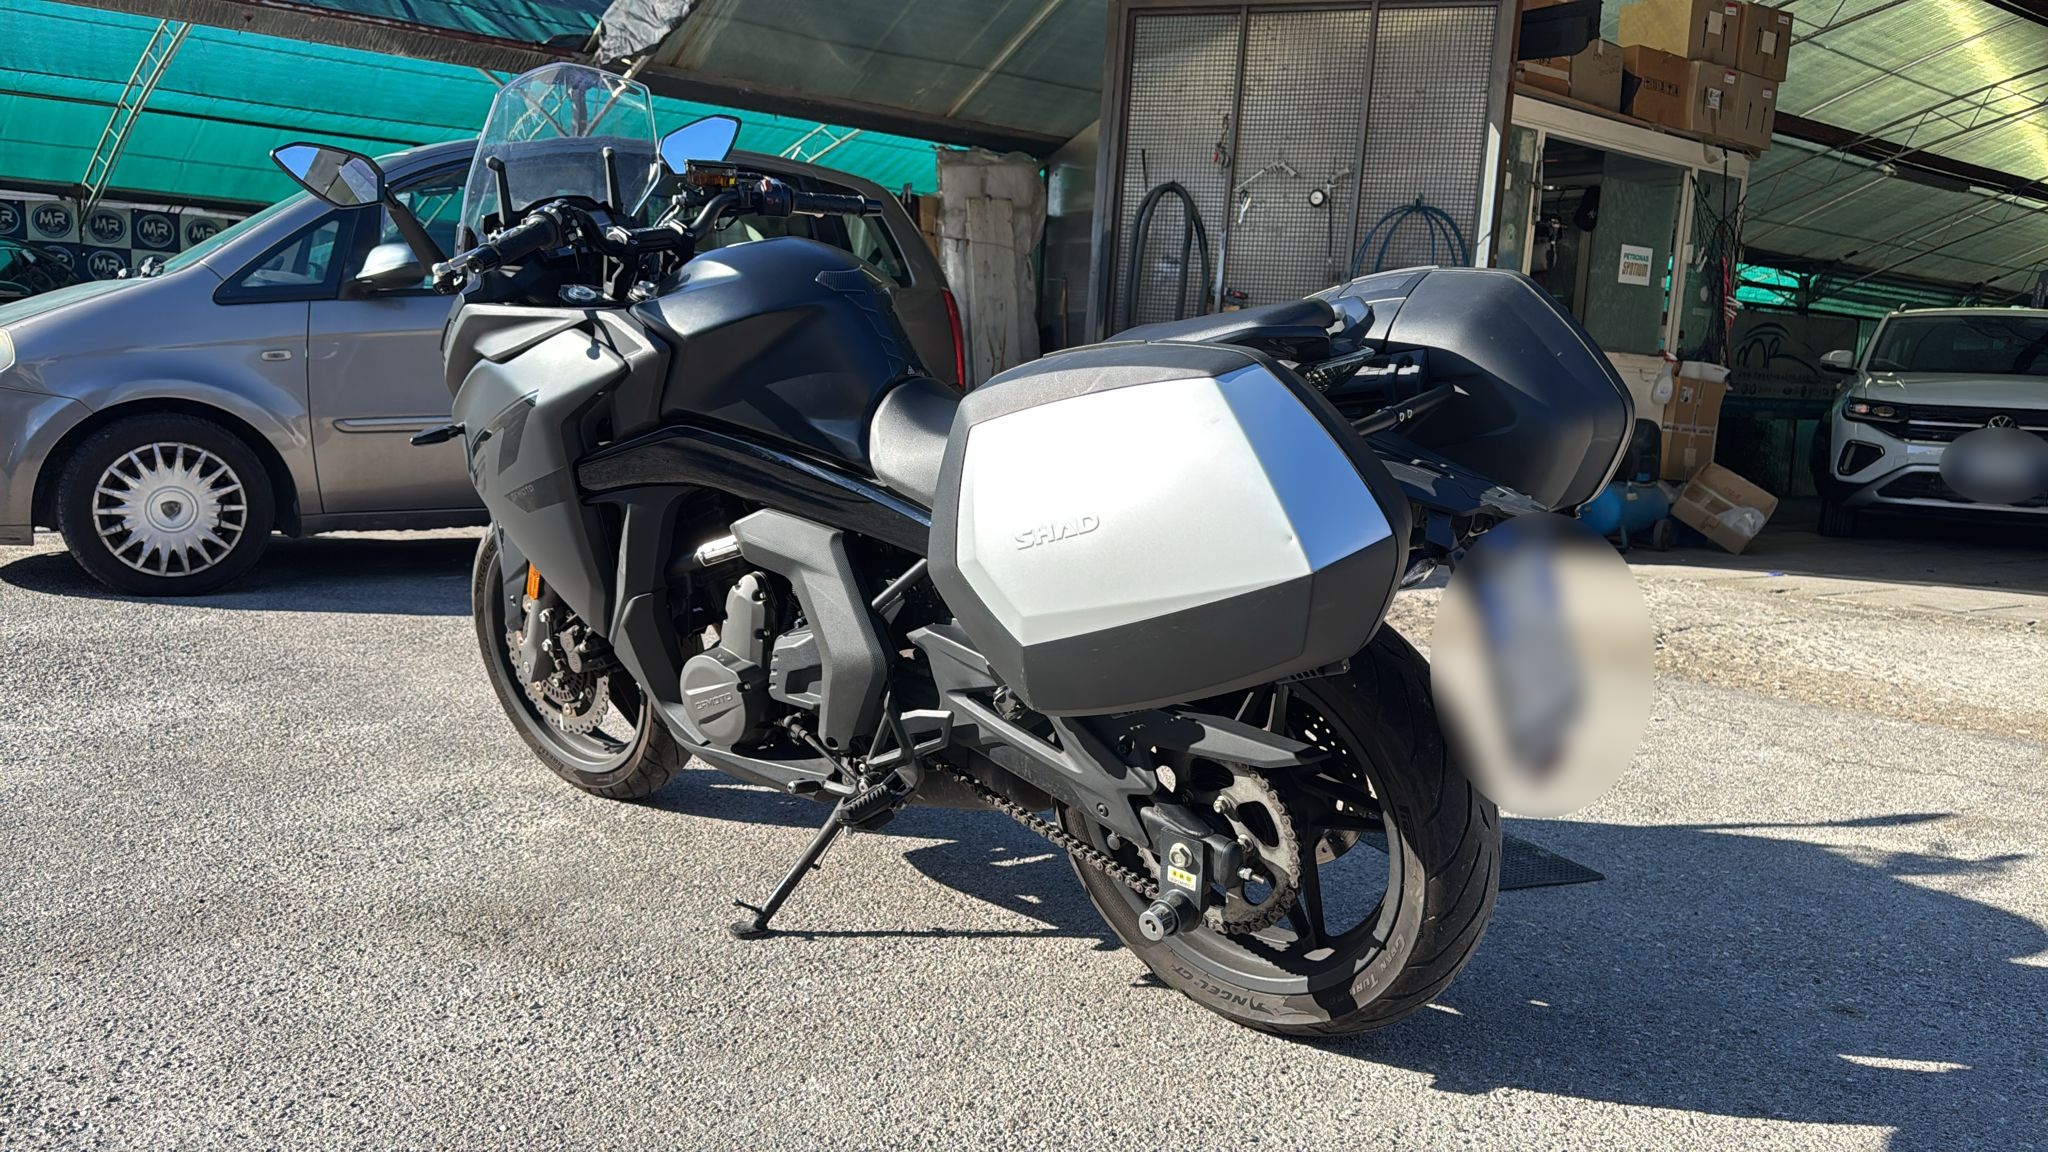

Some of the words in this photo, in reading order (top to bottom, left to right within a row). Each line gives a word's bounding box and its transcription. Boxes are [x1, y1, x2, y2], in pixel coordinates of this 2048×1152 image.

[39, 211, 66, 227] MR
[94, 216, 120, 233] MR
[143, 221, 168, 237] MR
[94, 257, 119, 274] MR
[1623, 252, 1649, 263] PETRONAS
[1014, 514, 1101, 551] SHAD
[1197, 979, 1271, 1016] ANGEL
